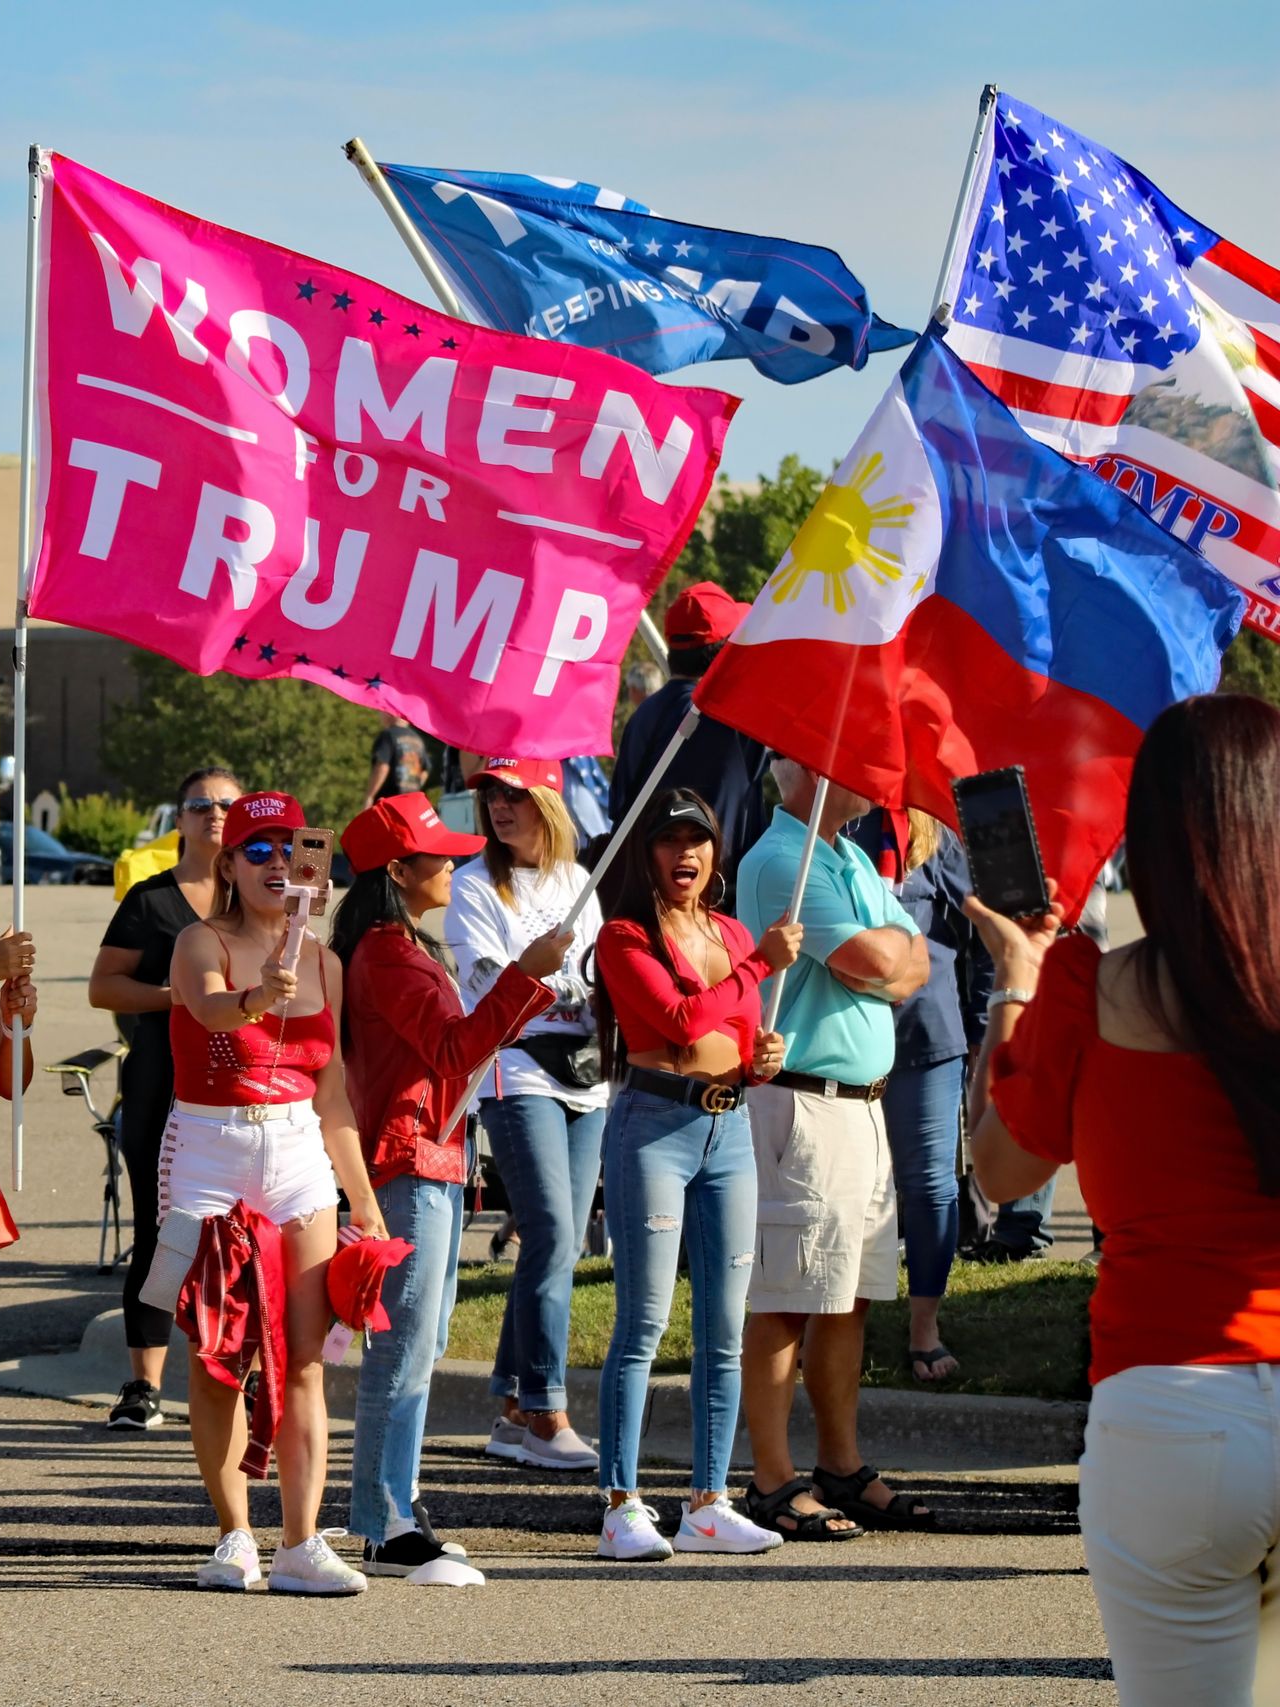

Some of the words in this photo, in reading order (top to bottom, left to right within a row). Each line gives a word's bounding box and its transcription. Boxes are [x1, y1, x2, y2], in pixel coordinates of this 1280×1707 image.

[524, 281, 664, 339] KEEPING
[89, 232, 695, 506] WOMEN
[294, 427, 451, 523] FOR
[67, 437, 610, 697] TRUMP
[243, 798, 286, 811] TRUMP
[250, 807, 285, 819] GIRL
